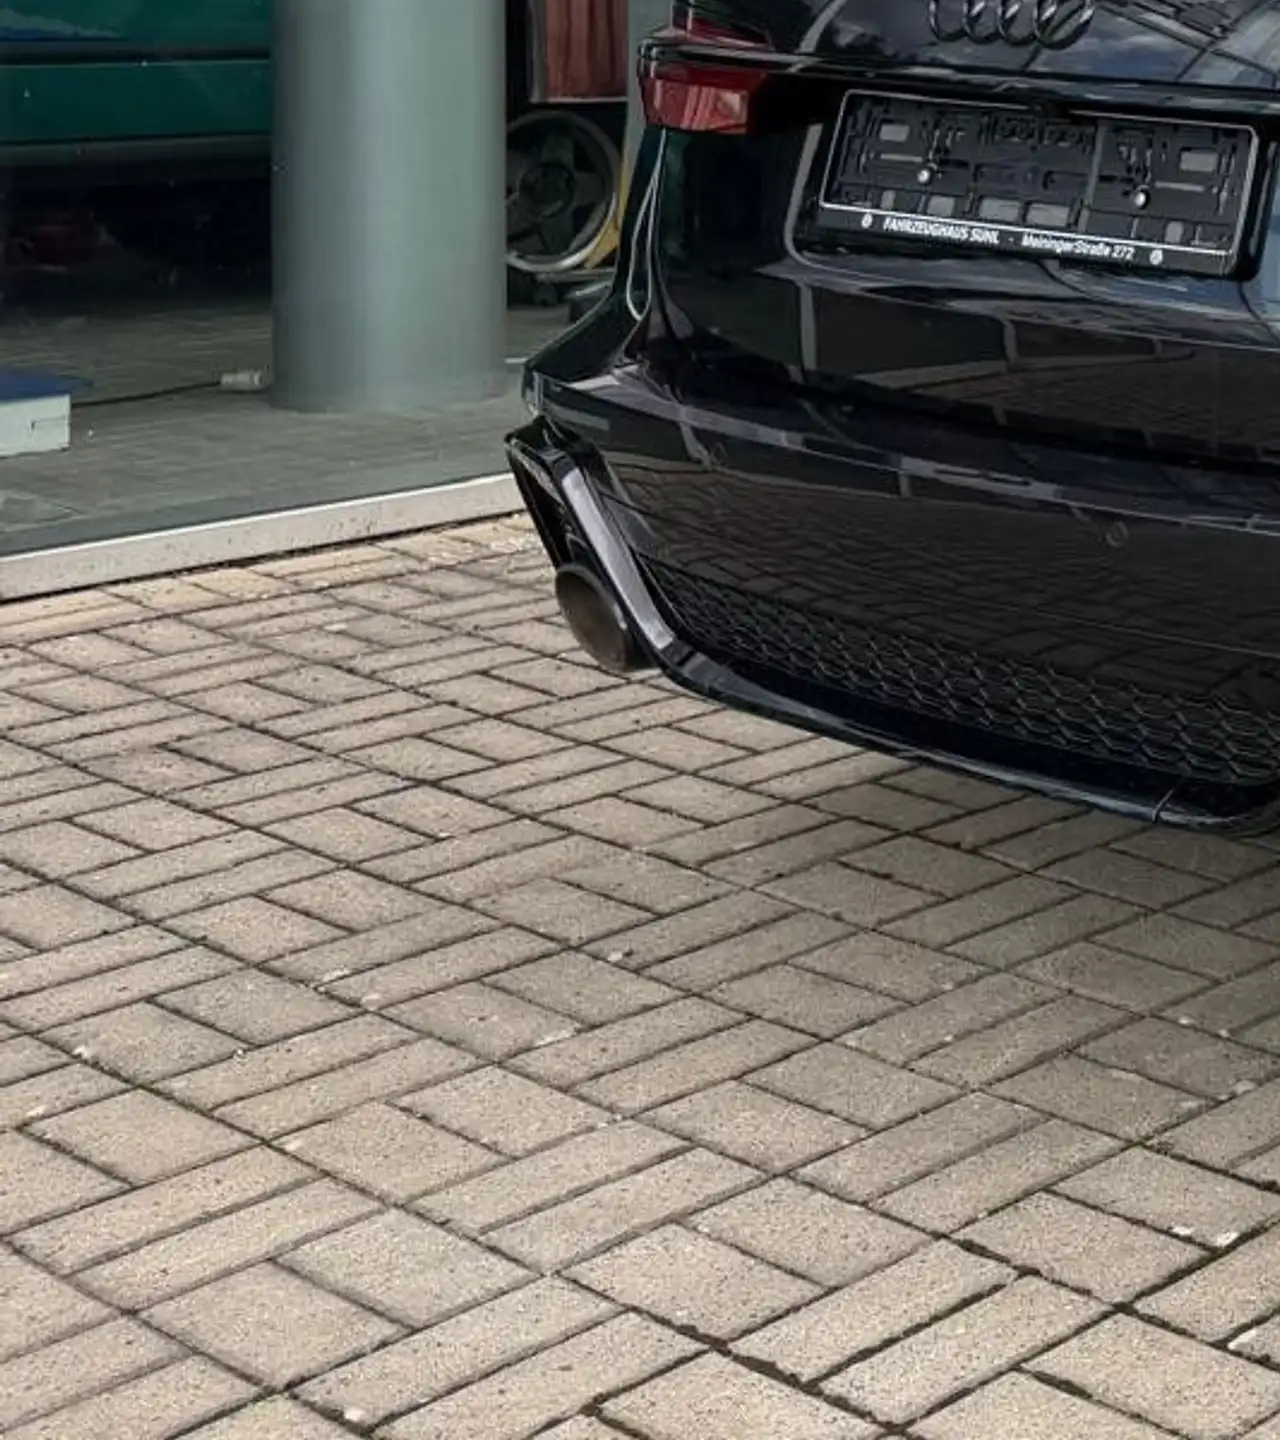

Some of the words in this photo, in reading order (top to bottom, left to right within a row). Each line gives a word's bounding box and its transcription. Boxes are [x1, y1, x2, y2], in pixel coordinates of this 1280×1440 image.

[883, 216, 969, 242] FAHRZEUGHAUS
[969, 228, 1000, 244] SUHL
[1112, 244, 1135, 260] 272
